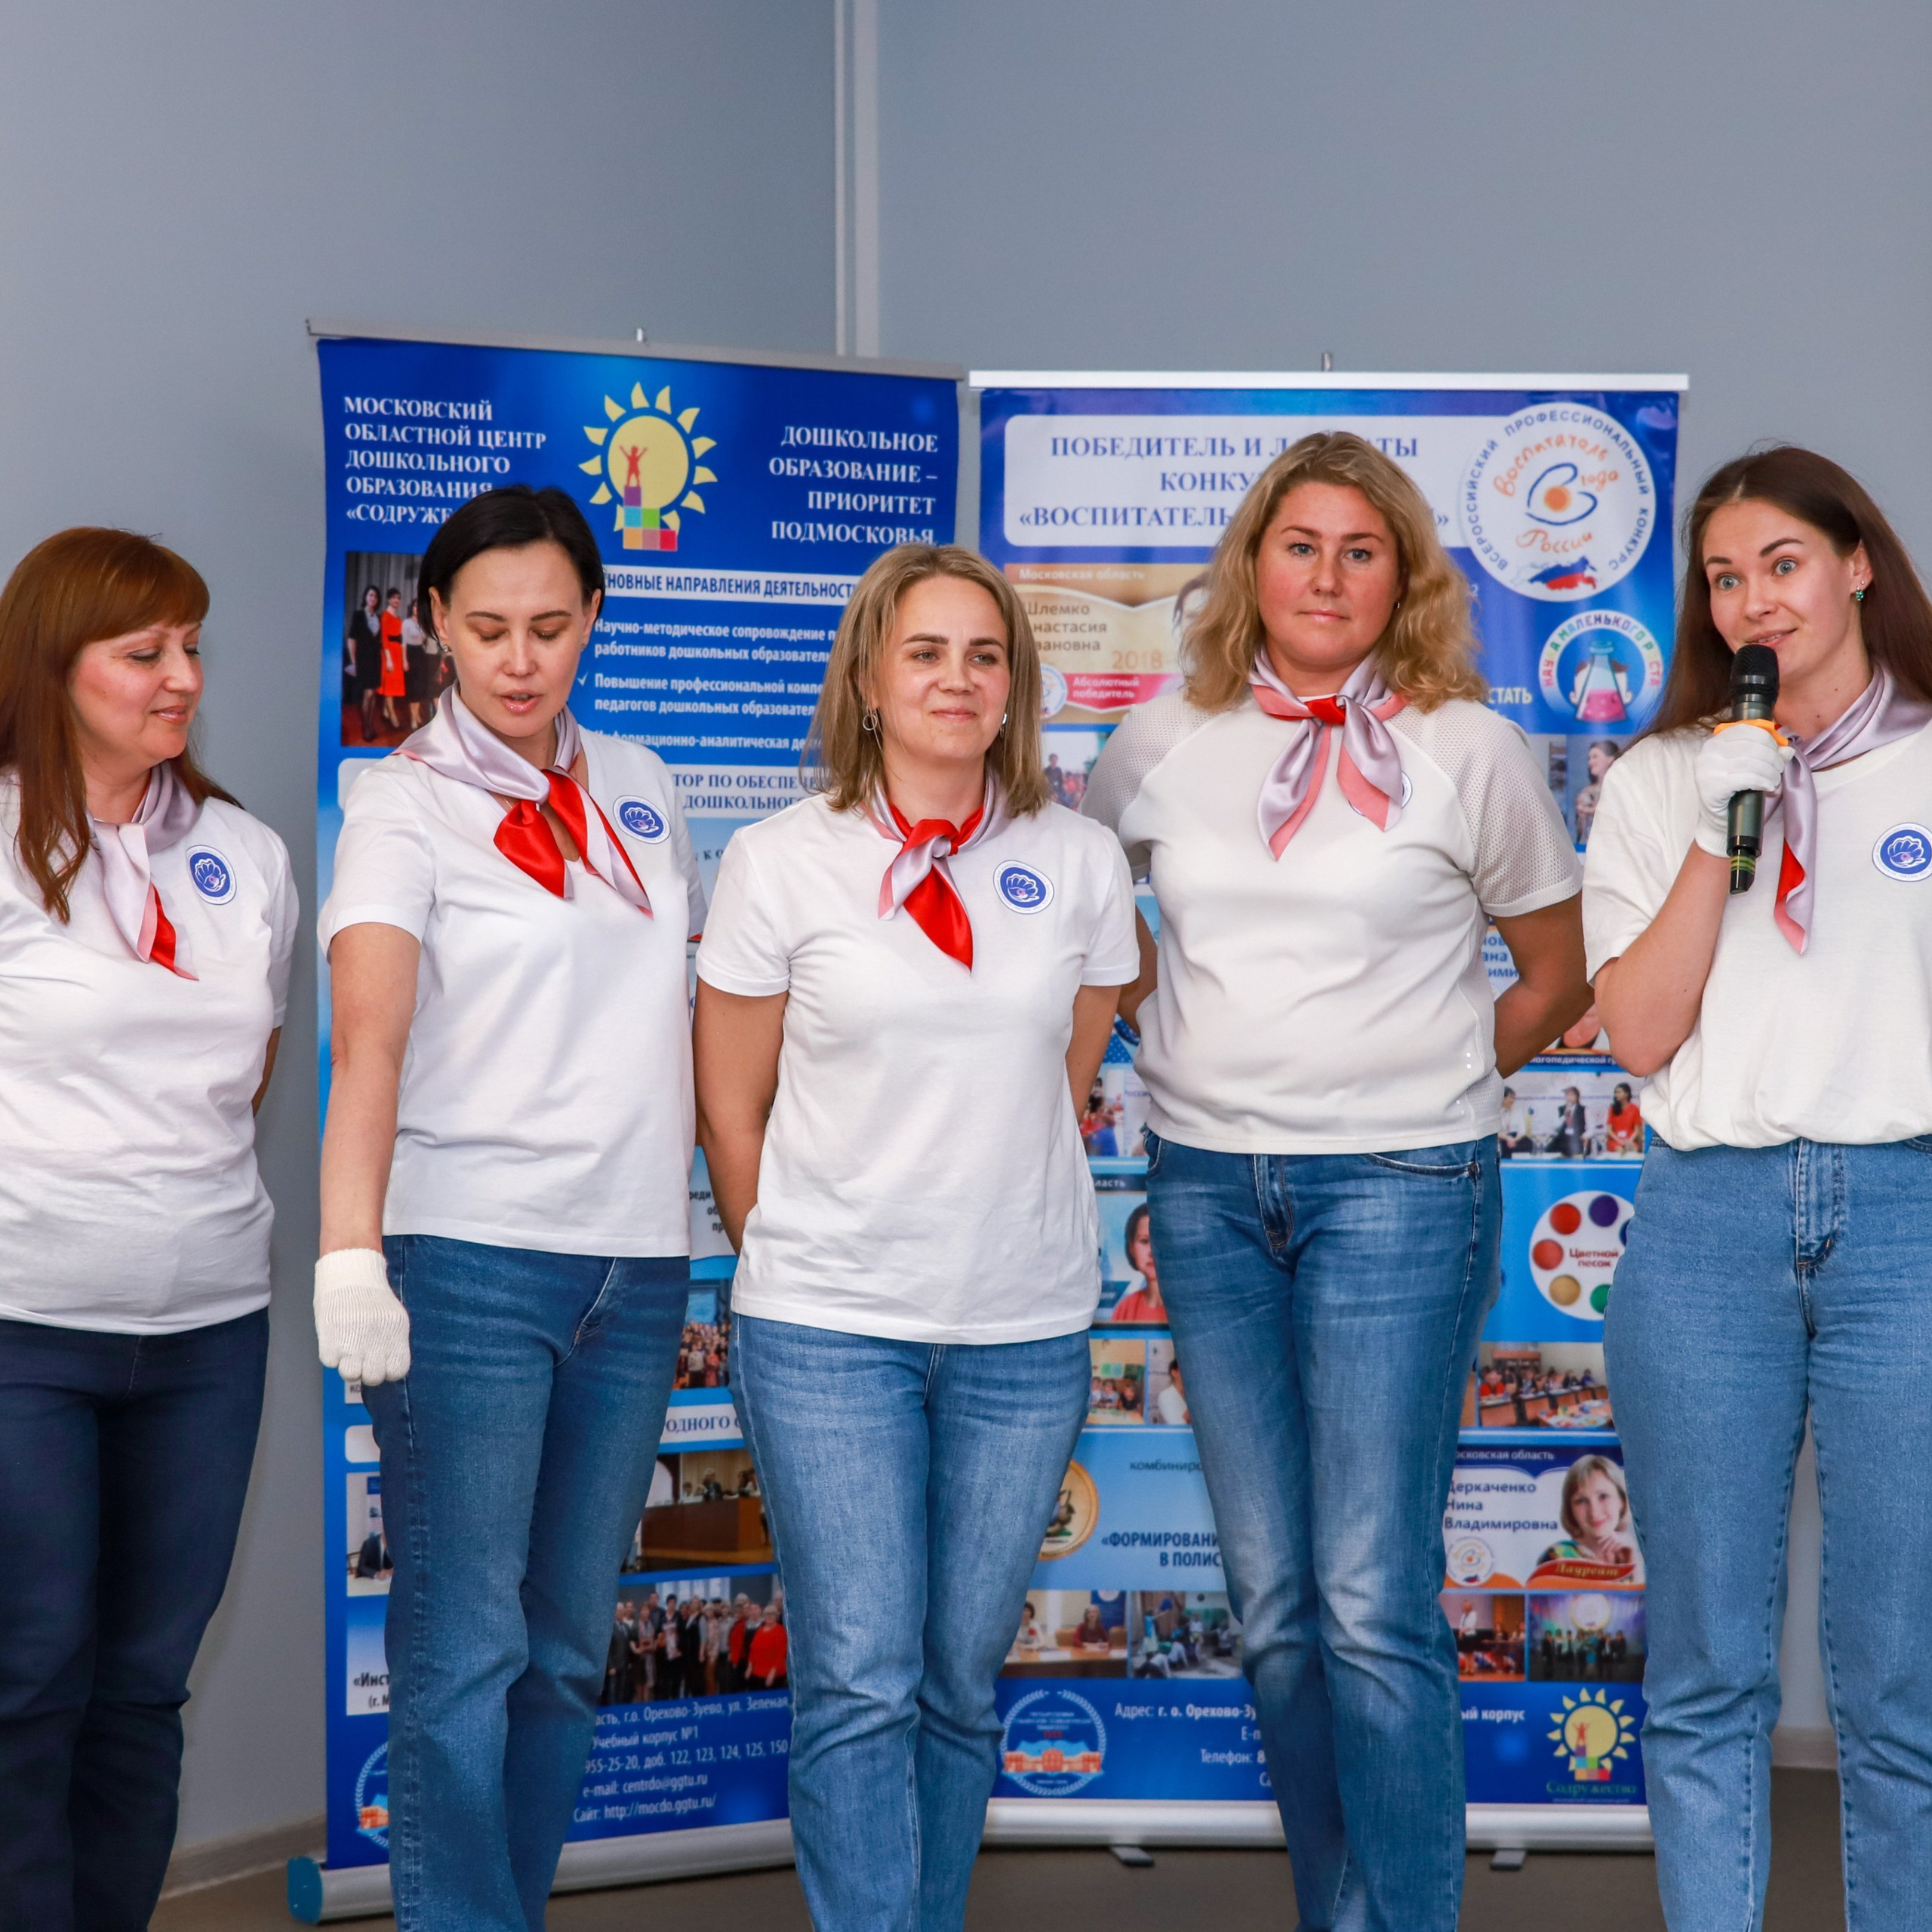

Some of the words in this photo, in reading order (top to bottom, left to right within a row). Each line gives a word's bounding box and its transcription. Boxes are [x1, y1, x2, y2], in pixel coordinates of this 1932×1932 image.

[344, 396, 493, 421] МОСКОВСКИЙ
[345, 423, 472, 447] ОБЛАСТНОЙ
[478, 429, 546, 450] ЦЕНТР
[781, 426, 938, 453] ДОШКОЛЬНОЕ
[1051, 438, 1235, 460] ПОБЕДИТЕЛЬ
[1245, 438, 1261, 457] И
[346, 450, 510, 473] ДОШКОЛЬНОГО
[769, 457, 921, 483] ОБРАЗОВАНИЕ
[1160, 472, 1259, 491] КОНКУ
[1466, 439, 1508, 571] ВСЕРОССИЙСКИЙ
[1504, 411, 1650, 495] ПРОФЕССИОНАЛЬНЫЙ
[1608, 507, 1648, 571] КОНКУРС
[808, 491, 936, 515] ПРИОРИТЕТ
[346, 503, 453, 525] «СОДРУЖЕ
[772, 521, 934, 546] ПОДМОСКОВЬЯ
[1097, 569, 1145, 580] область
[605, 574, 663, 590] НОВНЫЕ
[666, 575, 760, 595] НАПРАВЛЕНИЯ
[763, 580, 856, 598] ДЕЯТЕЛЬНОСТ
[595, 619, 730, 638] Научно-методическое
[732, 626, 826, 641] сопровождение
[1033, 623, 1107, 633] настасия
[595, 641, 666, 657] работников
[669, 646, 749, 660] дошкольных
[1036, 641, 1100, 651] вановна
[1112, 650, 1163, 670] 2018
[595, 673, 668, 690] Повышение
[670, 677, 785, 694] профессиональной
[1073, 677, 1140, 688] Абсолютный
[1073, 689, 1135, 699] победитель
[595, 699, 657, 714] педагогов
[659, 702, 739, 715] дошкольных
[742, 700, 815, 717] образовател
[673, 774, 703, 788] ТОР
[709, 774, 732, 788] ПО
[683, 795, 804, 811] ДОШКОЛЬНОГ
[1570, 1249, 1619, 1259] Цветной
[1578, 1260, 1612, 1268] песок
[666, 1416, 731, 1433] ОДНОГО
[1456, 1451, 1509, 1460] осковская
[1511, 1449, 1555, 1460] область
[1130, 1459, 1203, 1473] комбиниро
[1444, 1517, 1558, 1533] Владимировна
[1101, 1532, 1218, 1547] «ФОРМИРОВАНИ
[1160, 1552, 1169, 1566] В
[1173, 1552, 1221, 1567] ПОЛИС
[1115, 1703, 1155, 1719] Адрес:
[1481, 1709, 1525, 1724] корпус
[592, 1731, 639, 1749] Учебный
[642, 1730, 678, 1746] корпус
[644, 1752, 666, 1770] доб.
[671, 1749, 691, 1764] 122,
[696, 1746, 716, 1762] 123,
[721, 1744, 741, 1760] 124,
[746, 1742, 766, 1758] 125,
[1201, 1748, 1253, 1766] Телефон:
